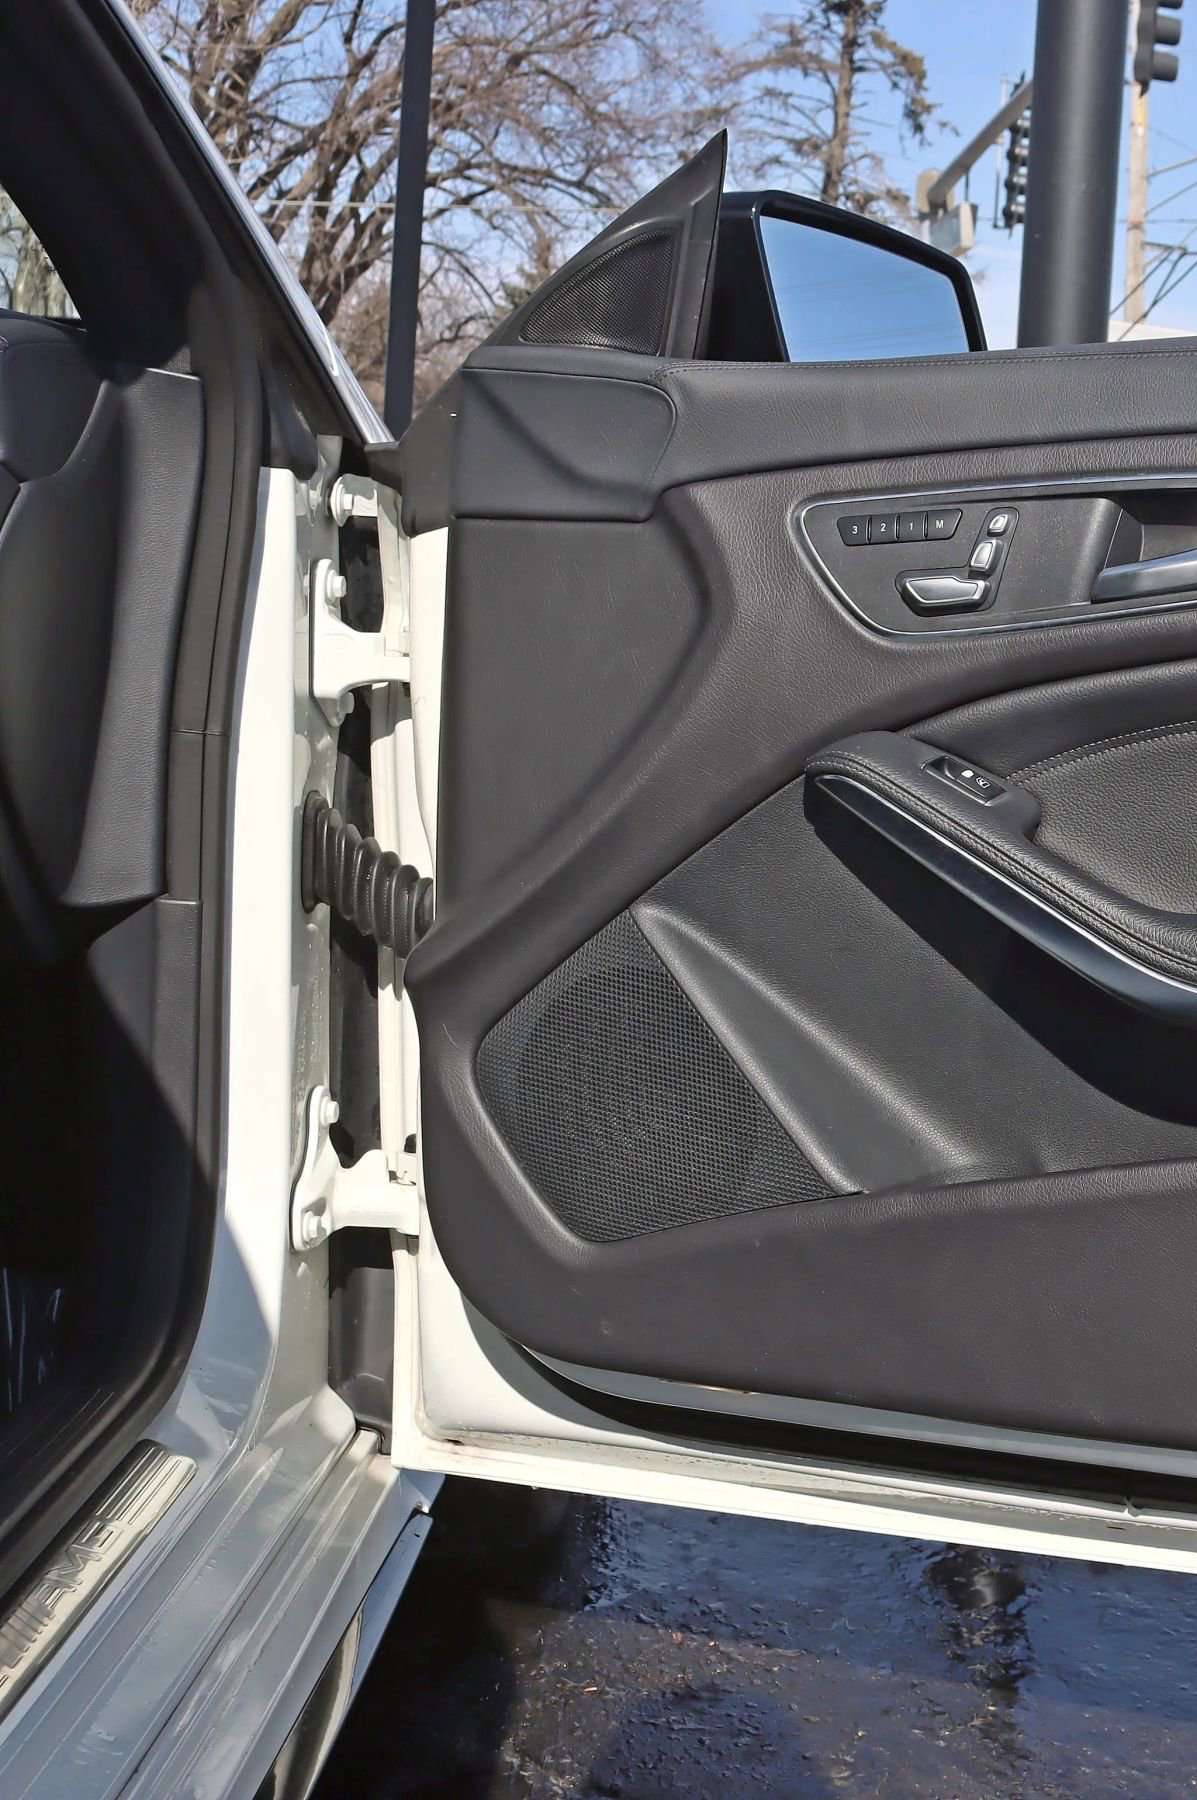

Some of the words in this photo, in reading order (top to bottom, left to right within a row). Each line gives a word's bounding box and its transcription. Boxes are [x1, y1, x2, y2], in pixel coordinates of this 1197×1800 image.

[851, 525, 859, 535] 3
[880, 522, 887, 532] 2
[909, 522, 914, 531] 1
[935, 519, 944, 529] M
[26, 1519, 124, 1611] AMG
